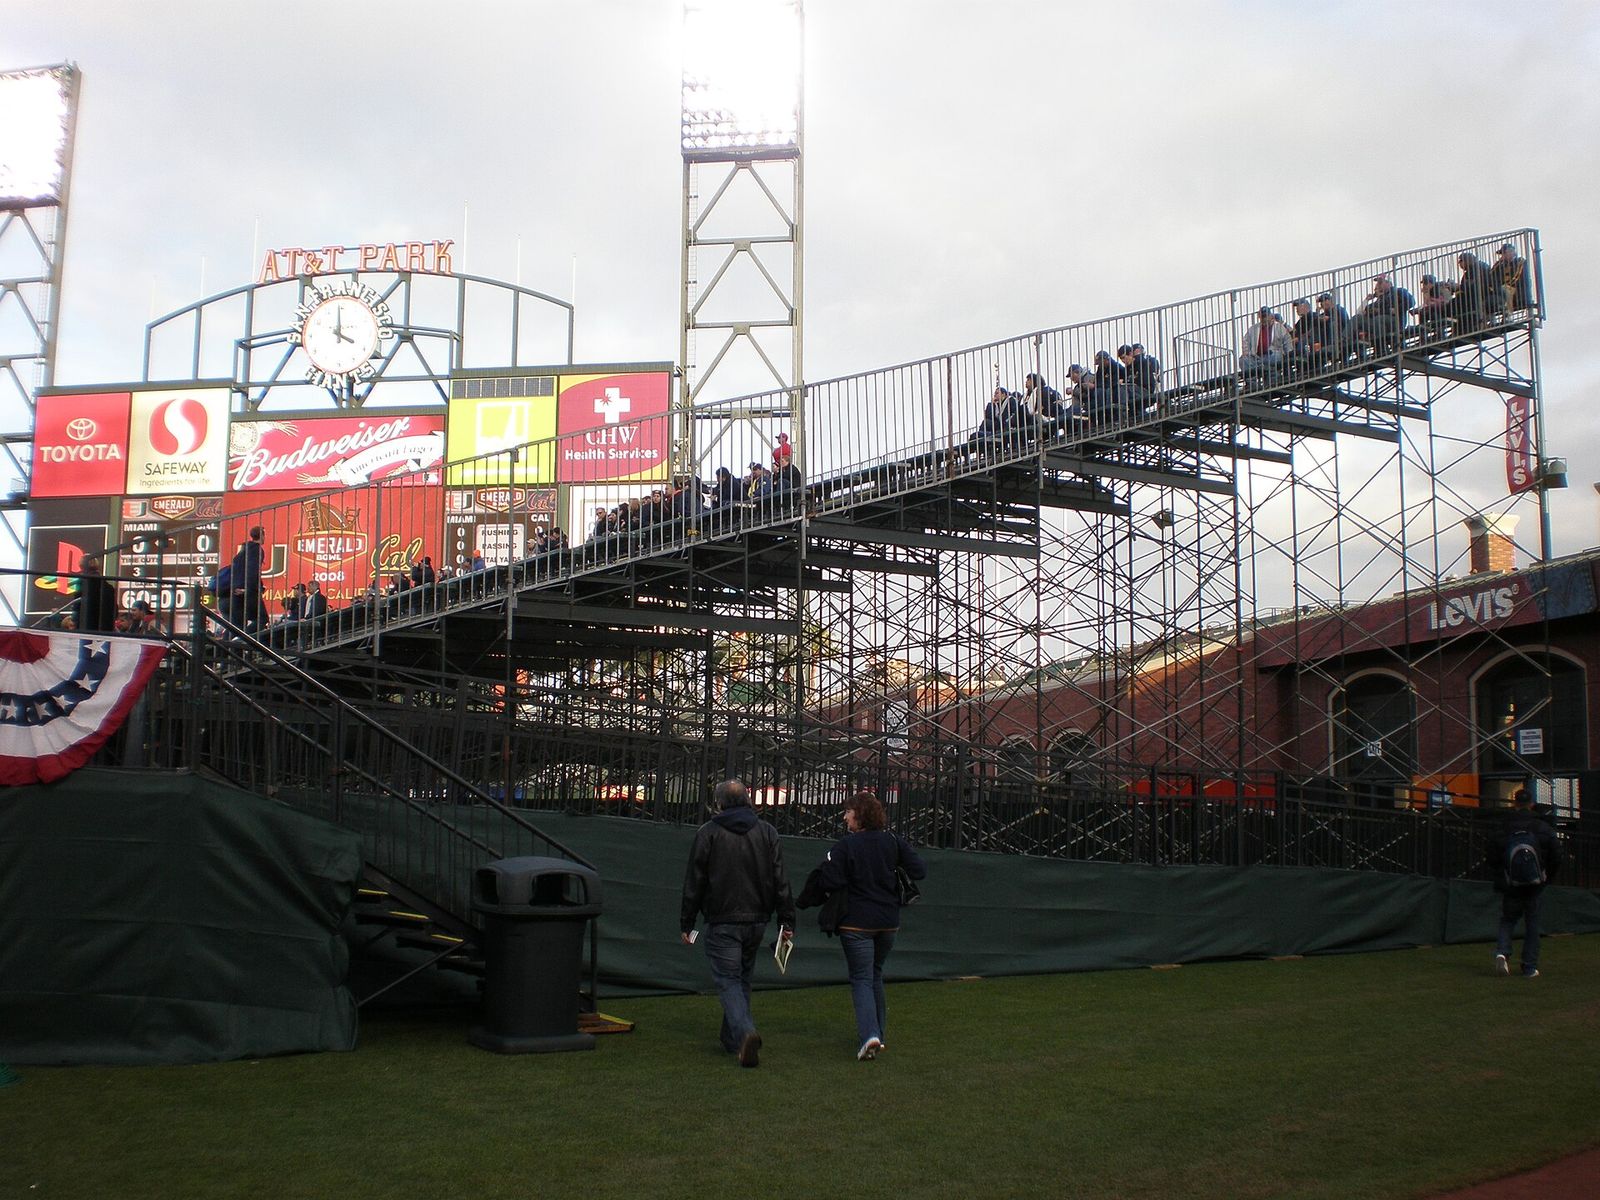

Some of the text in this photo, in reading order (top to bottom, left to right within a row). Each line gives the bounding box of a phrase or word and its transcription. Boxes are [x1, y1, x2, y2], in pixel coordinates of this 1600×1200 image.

[257, 239, 454, 283] AT&T PARK
[286, 302, 313, 344] SAN
[304, 360, 376, 390] GIANTS
[585, 425, 638, 446] CHW
[40, 443, 121, 464] TOYOTA
[230, 416, 411, 491] Budweiser
[565, 447, 659, 461] Health Services
[144, 461, 207, 476] SAFEWAY
[480, 490, 523, 502] EMERAD
[153, 498, 193, 510] EMERALD
[447, 515, 477, 524] MIAMI
[530, 513, 550, 522] CAL
[123, 523, 158, 532] MIAMI
[196, 534, 210, 553] 0
[297, 536, 364, 554] EMERALD
[482, 542, 517, 550] PASSING
[315, 553, 343, 561] BOWL
[132, 566, 141, 577] 3
[196, 565, 204, 576] 3
[313, 571, 345, 582] 2008
[121, 589, 187, 609] 60:00
[260, 588, 297, 601] MIAM
